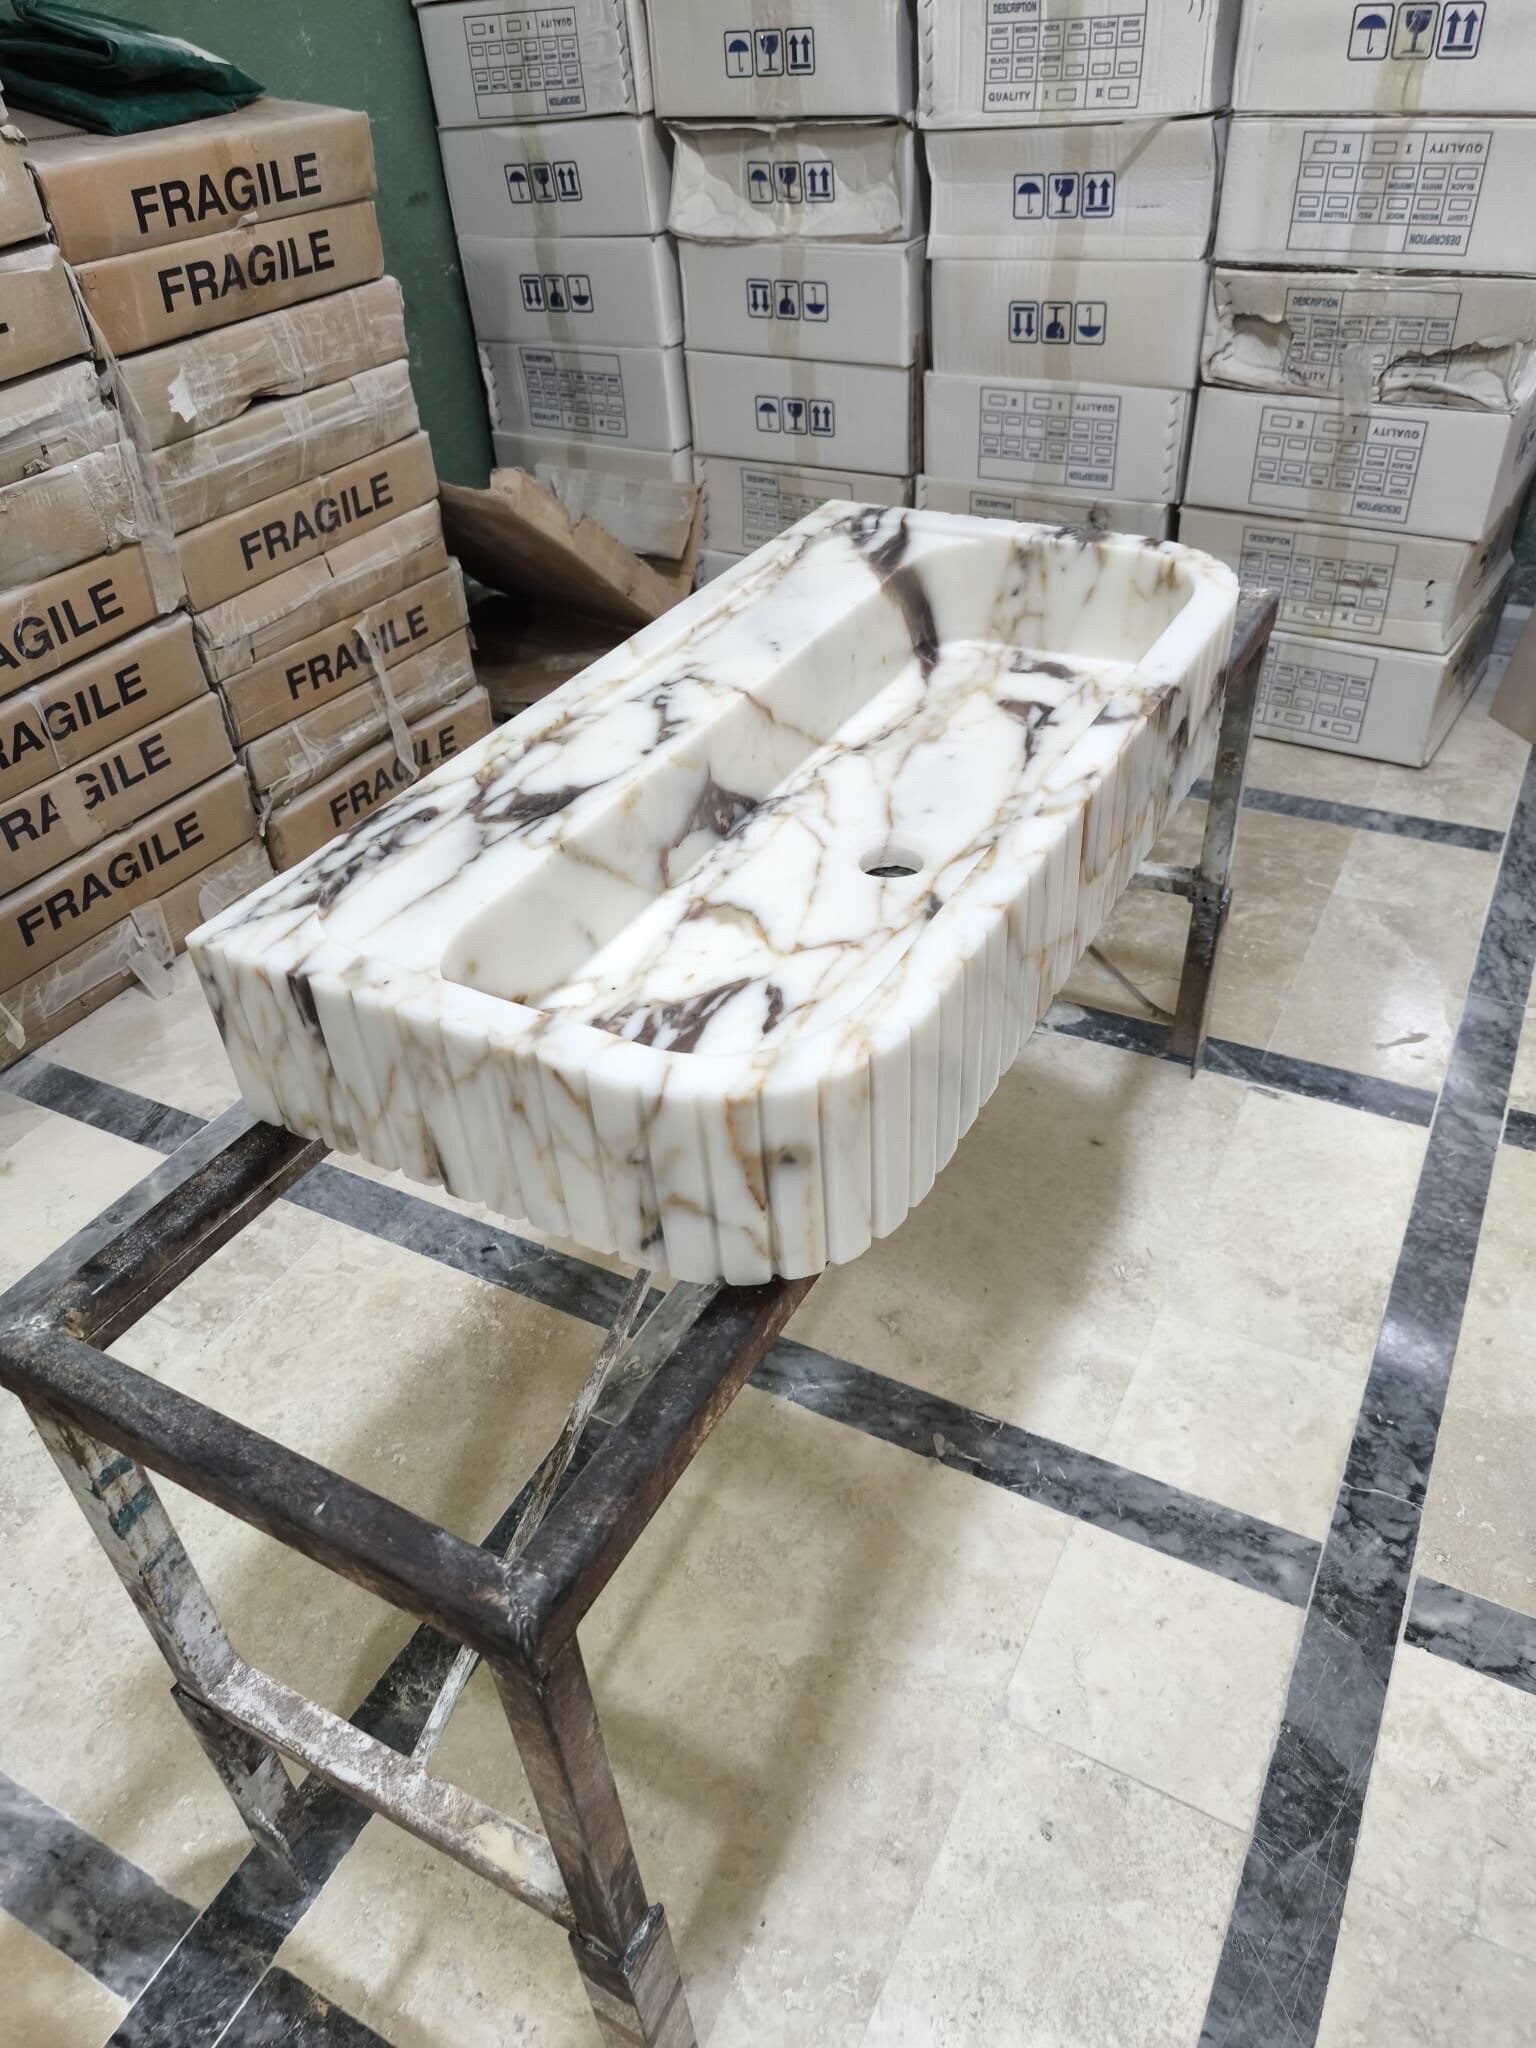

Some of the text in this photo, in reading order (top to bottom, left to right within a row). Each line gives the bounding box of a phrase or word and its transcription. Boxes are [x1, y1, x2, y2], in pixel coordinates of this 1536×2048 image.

[541, 17, 572, 29] QUALITY
[988, 91, 1031, 103] QUALITY
[1429, 143, 1484, 154] QUALITY
[131, 152, 322, 234] FRAGILE
[1450, 183, 1475, 191] BLACK
[1447, 213, 1468, 222] LIGHT
[1409, 233, 1462, 246] DESCRIPTION
[157, 229, 335, 314] FRAGILE
[1075, 402, 1115, 413] QUALITY
[1372, 427, 1420, 440] QUALITY
[239, 472, 393, 571] FRAGILE
[17, 812, 204, 947] FRAGILE
